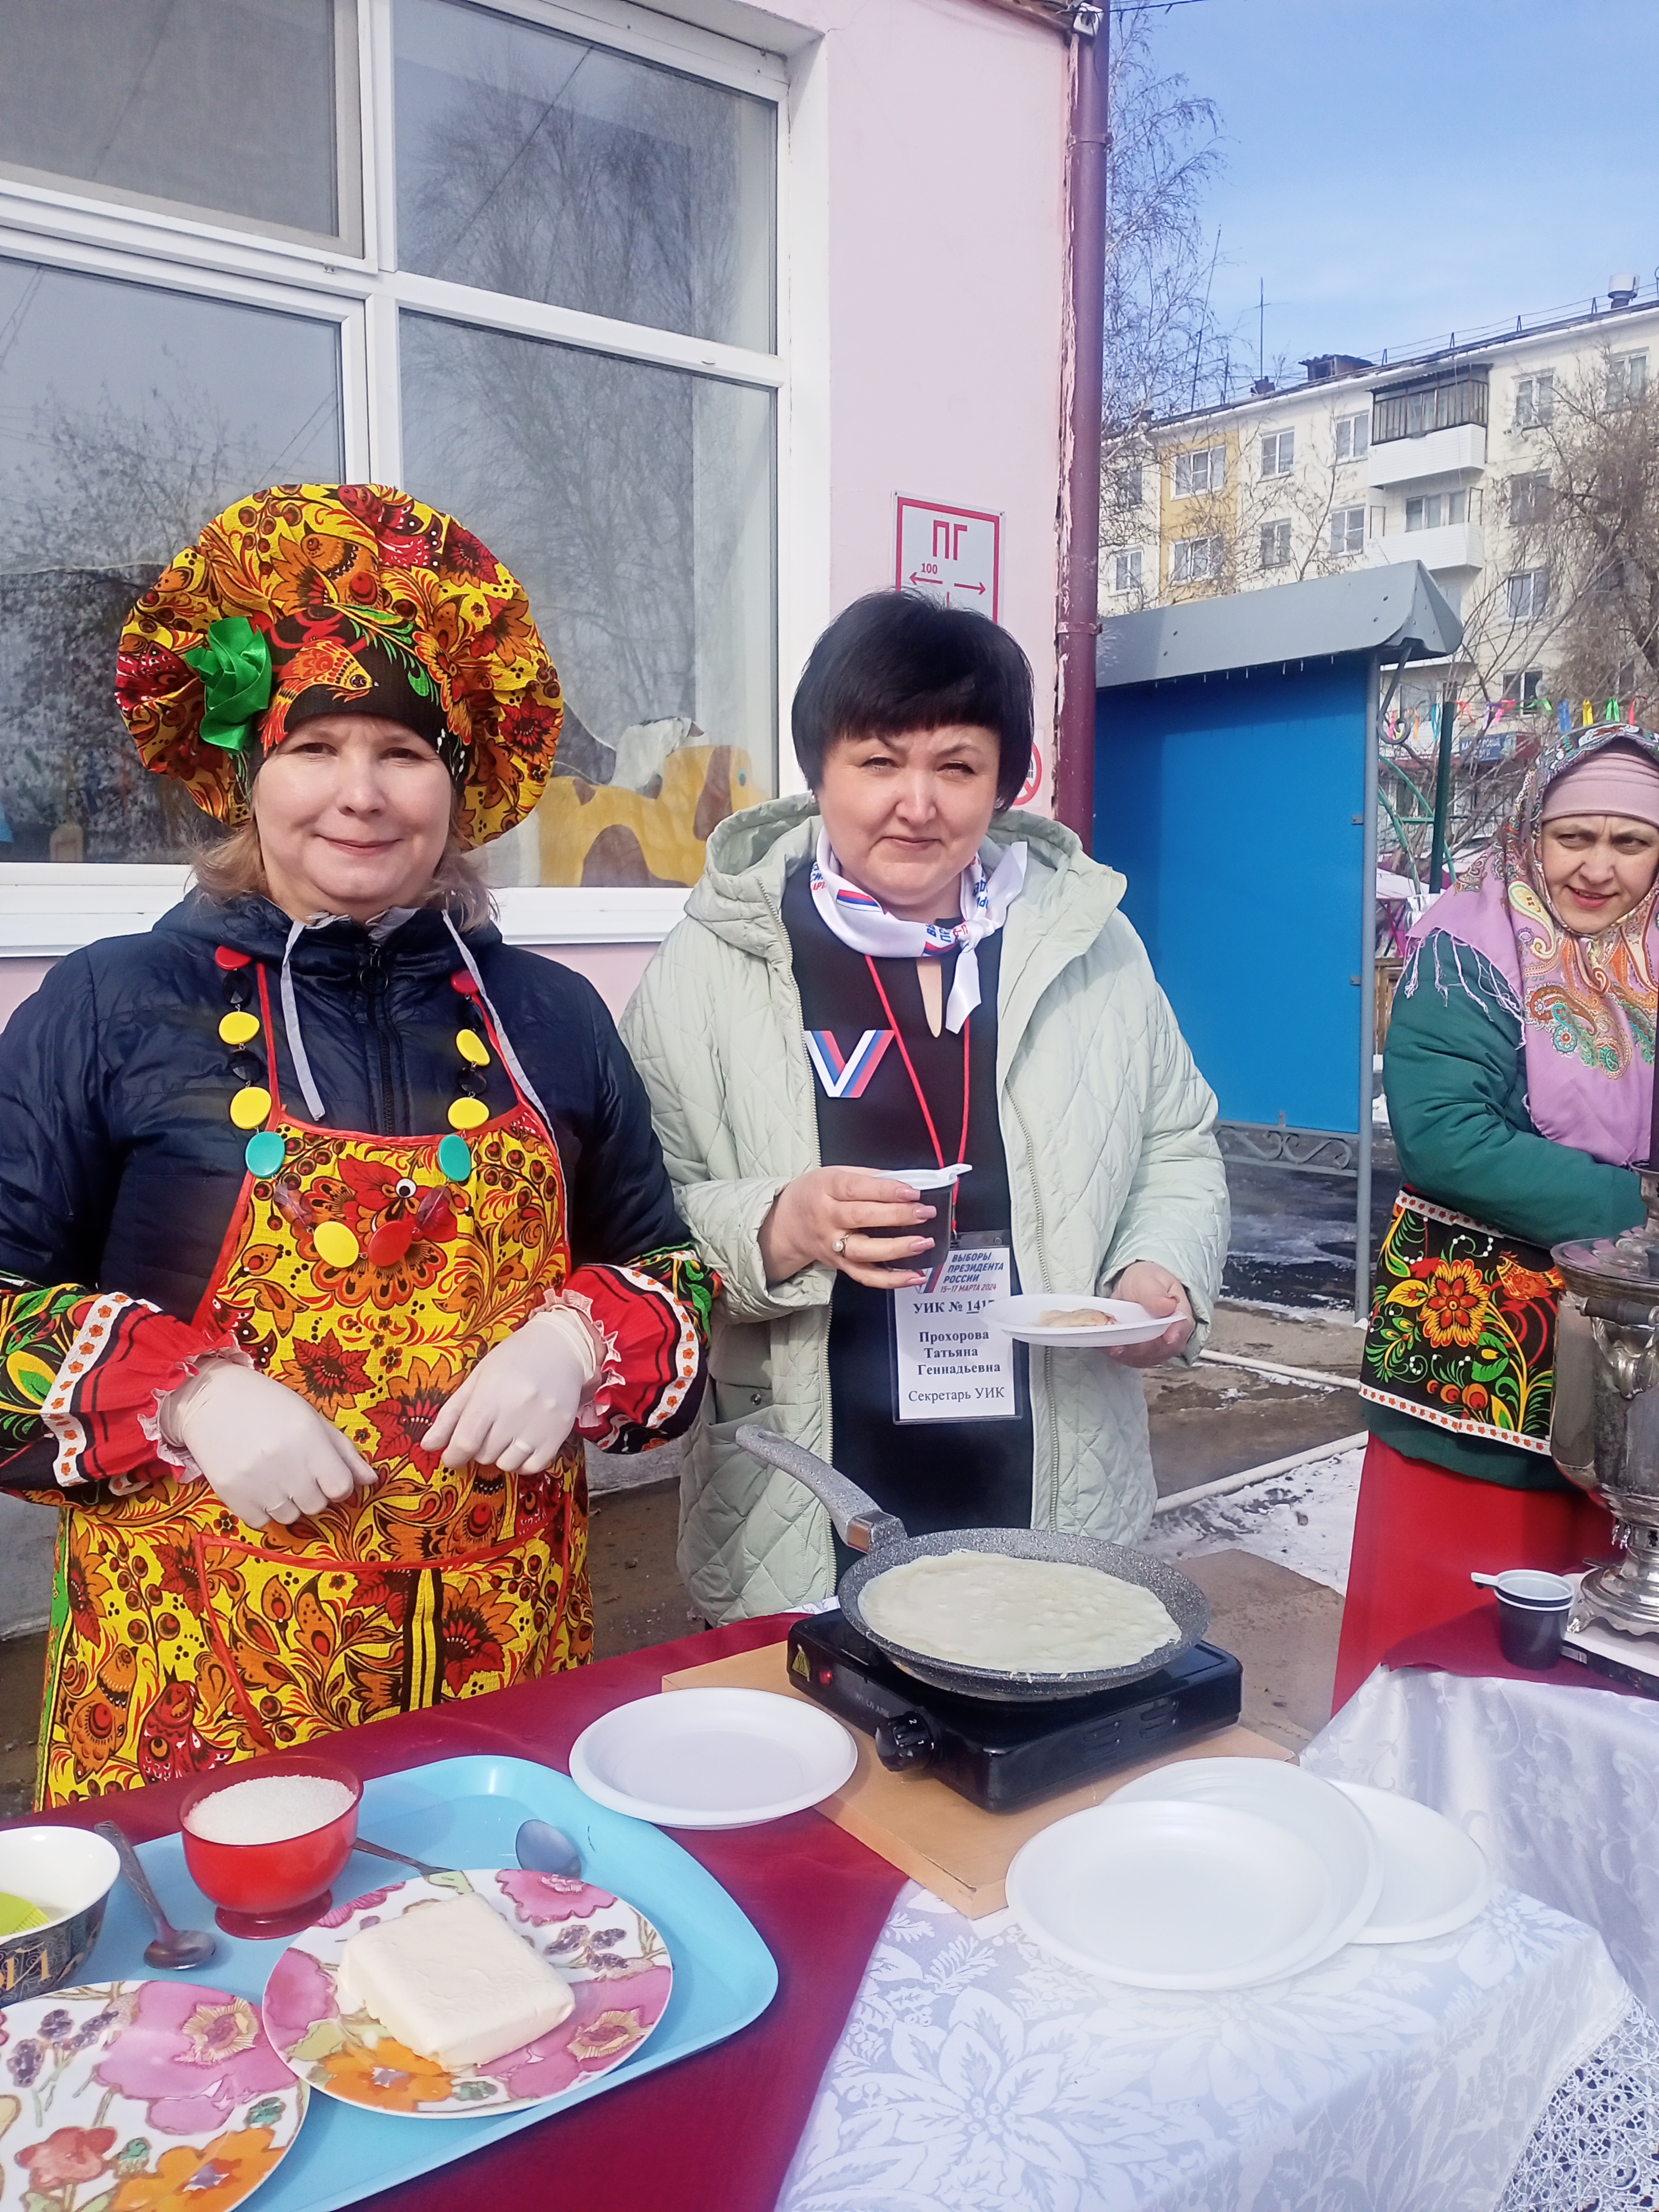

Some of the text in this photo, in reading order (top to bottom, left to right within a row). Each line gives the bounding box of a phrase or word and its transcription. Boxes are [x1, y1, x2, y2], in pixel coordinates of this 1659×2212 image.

[932, 519, 968, 561] ПГ
[921, 562, 938, 575] 100
[952, 1252, 992, 1262] ВЫБОРЫ
[947, 1262, 1004, 1273] ПРЕЗИДЕНТА
[943, 1274, 980, 1284] РОССИИ
[958, 1284, 980, 1292] МАРТА
[980, 1283, 997, 1291] 2024
[913, 1300, 995, 1314] УИК № 141
[919, 1331, 989, 1345] Прохорова
[924, 1347, 978, 1359] Татьяна
[917, 1363, 1001, 1375] Геннадьевна
[908, 1387, 1005, 1404] Секретарь УИК
